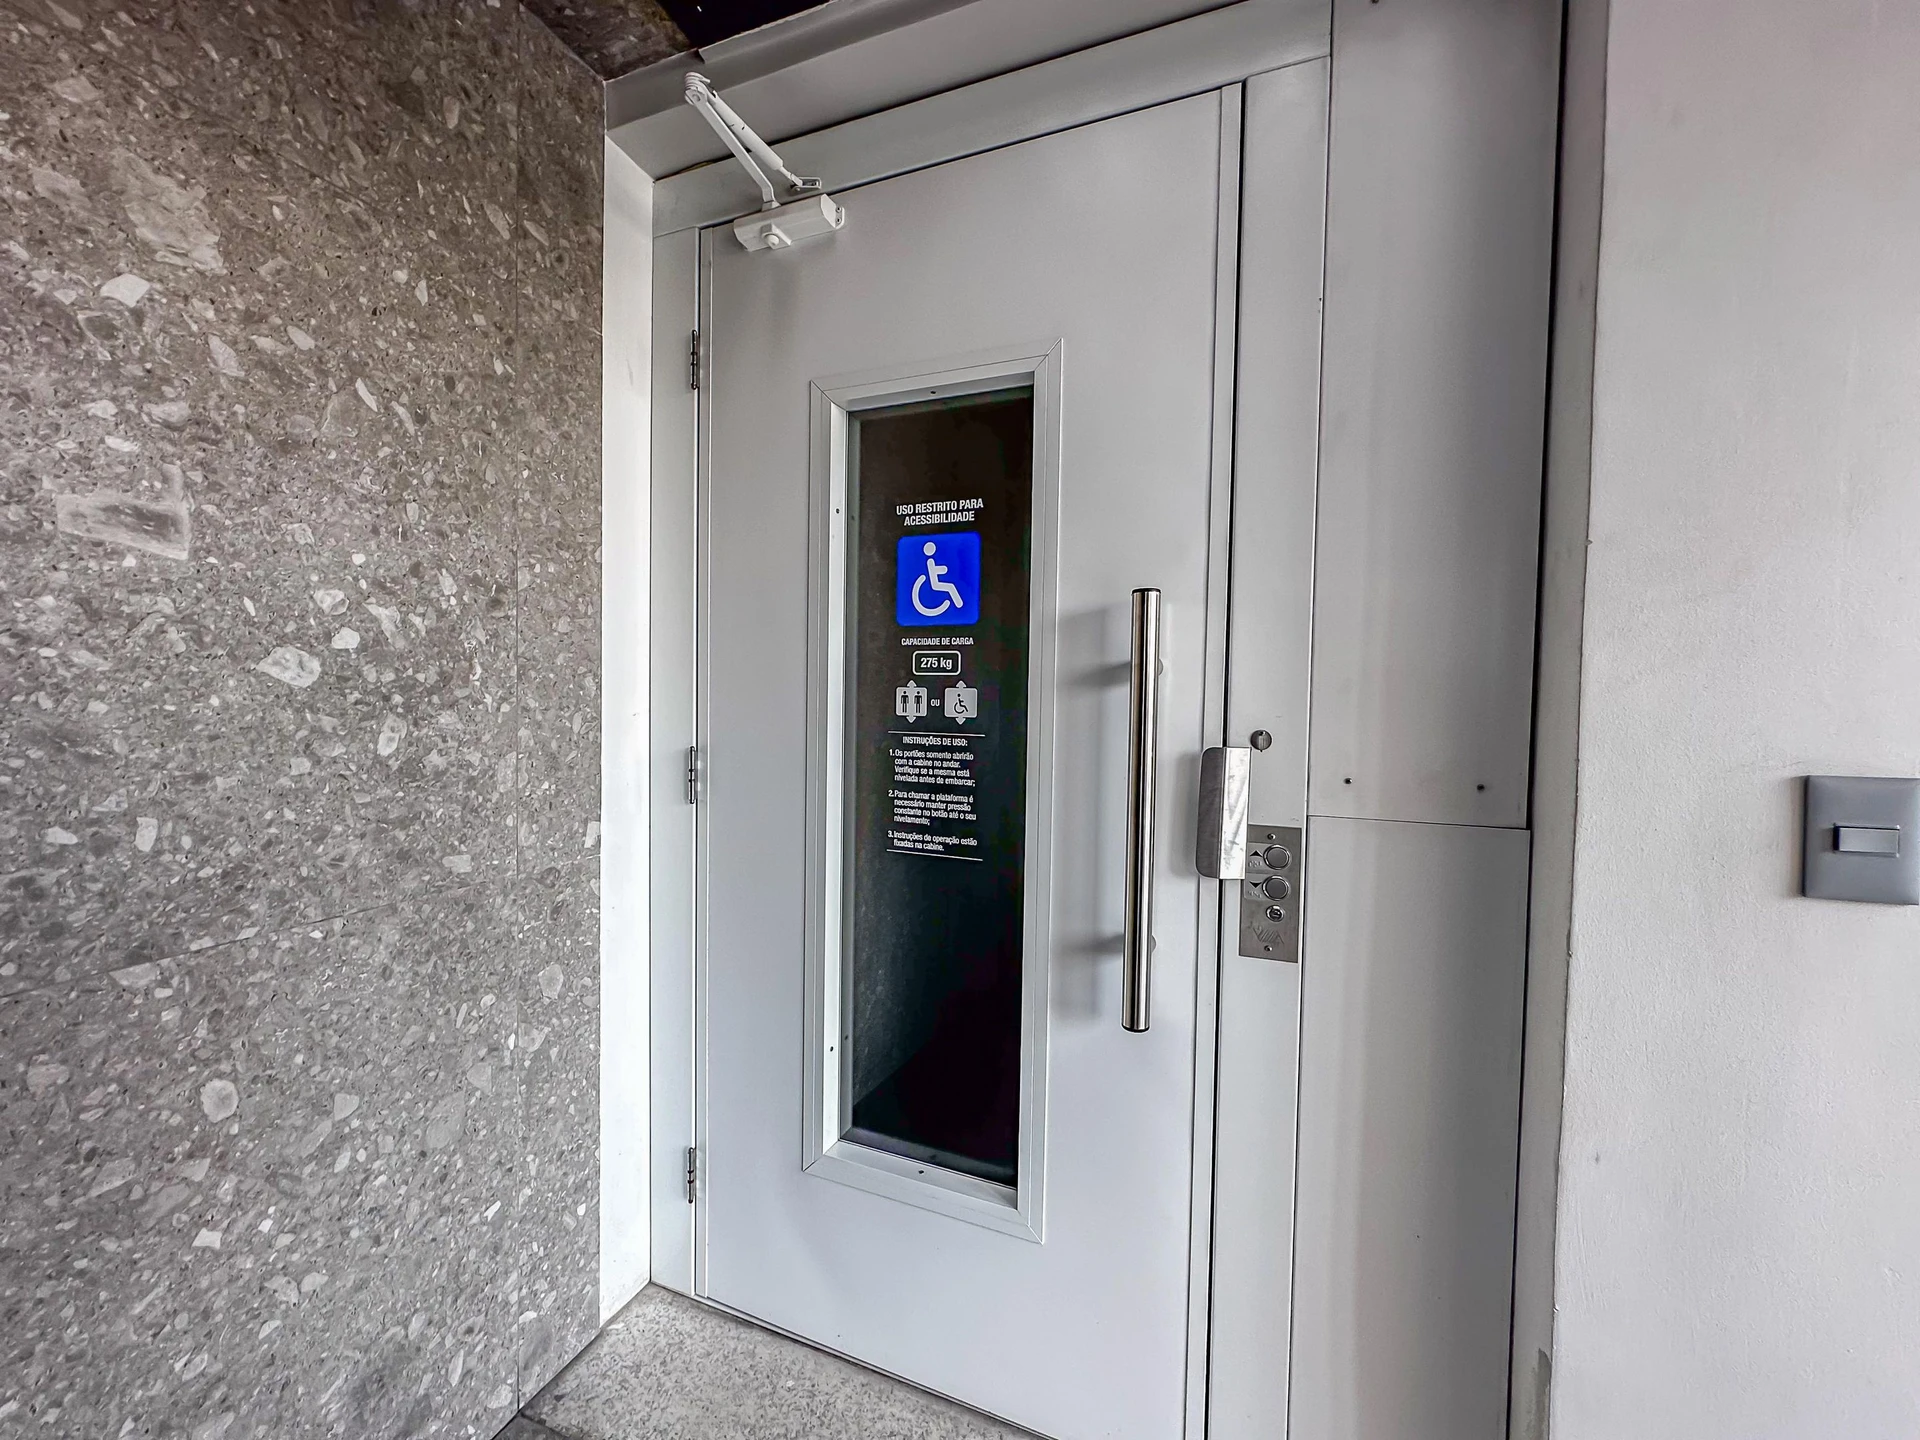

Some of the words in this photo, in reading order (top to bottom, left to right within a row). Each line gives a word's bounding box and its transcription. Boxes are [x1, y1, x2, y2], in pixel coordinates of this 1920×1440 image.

[896, 504, 913, 516] USO
[915, 500, 957, 514] RESTRITO
[959, 498, 984, 510] PARA
[903, 511, 975, 526] ACESSIBILIDADE
[901, 638, 940, 646] CAPACIDADE
[951, 637, 974, 645] CARGA
[920, 657, 938, 668] 275
[940, 657, 953, 670] kg
[930, 699, 940, 707] OU
[902, 736, 941, 746] INSTRUÇÕES
[942, 738, 952, 746] DE
[952, 738, 968, 746] USO:
[903, 749, 925, 758] portões
[926, 751, 952, 759] somente
[952, 752, 974, 760] abrirão
[942, 760, 961, 768] andar.
[894, 766, 920, 775] Verifique
[956, 769, 970, 777] está
[894, 774, 918, 782] nivelada
[908, 791, 930, 800] chamar
[936, 793, 968, 803] plataforma
[969, 795, 974, 803] é
[894, 799, 925, 808] necessário
[925, 801, 947, 809] manter
[947, 803, 971, 811] pressão
[893, 807, 922, 816] constante
[931, 809, 948, 818] botão
[949, 811, 959, 819] até
[893, 839, 914, 848] fixadas
[914, 841, 922, 849] na
[923, 842, 945, 851] cabine.
[923, 833, 932, 841] de
[932, 835, 960, 845] operação
[960, 837, 978, 846] estão
